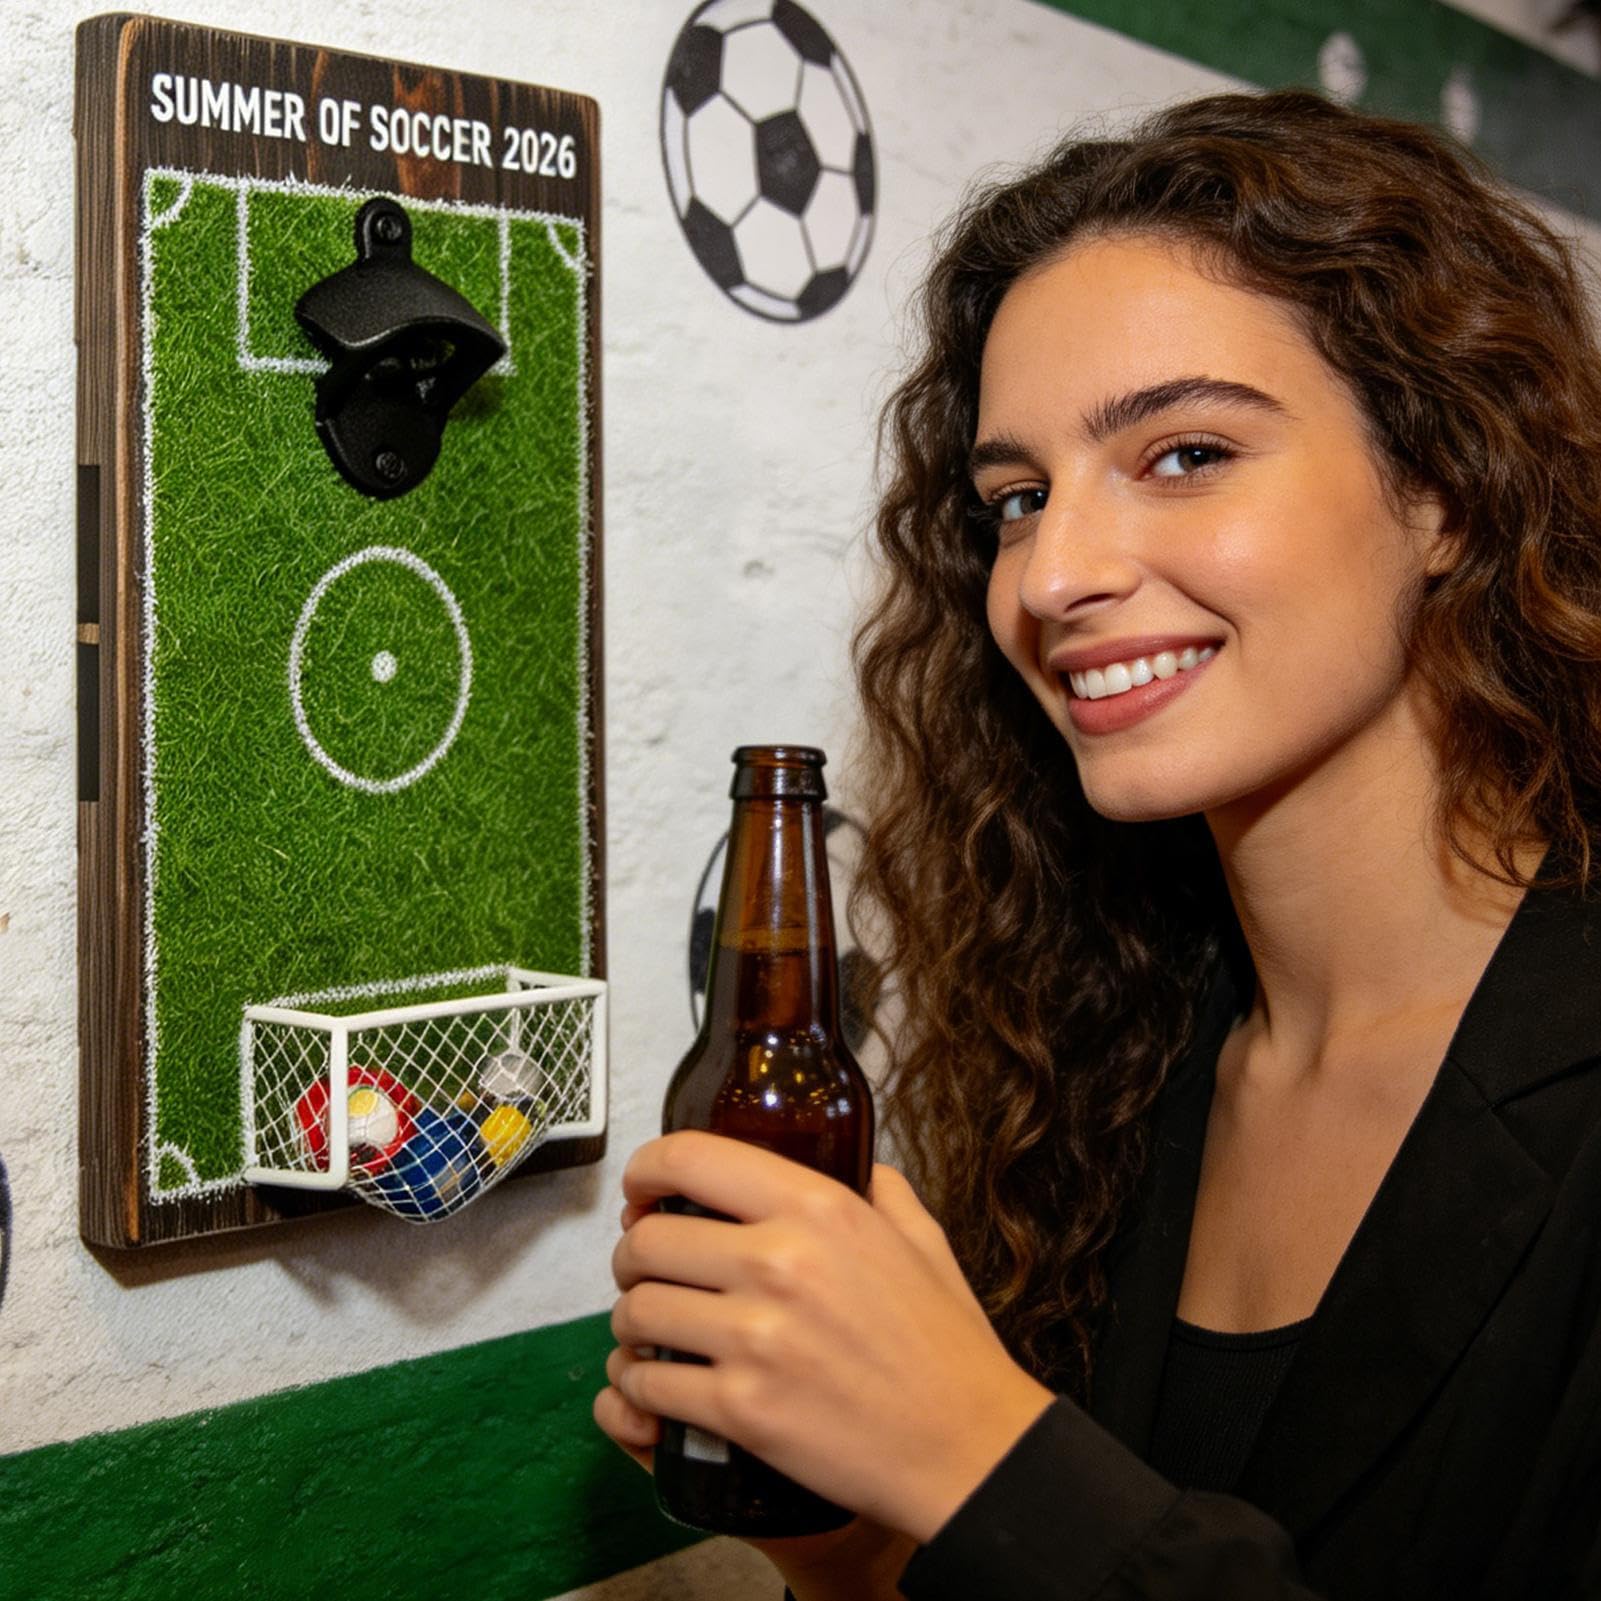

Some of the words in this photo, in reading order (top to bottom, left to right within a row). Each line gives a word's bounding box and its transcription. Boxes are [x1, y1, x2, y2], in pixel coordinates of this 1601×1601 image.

[150, 73, 306, 142] SUMMER
[319, 97, 362, 147] OF
[369, 104, 493, 168] SOCCER
[502, 126, 577, 179] 2026
